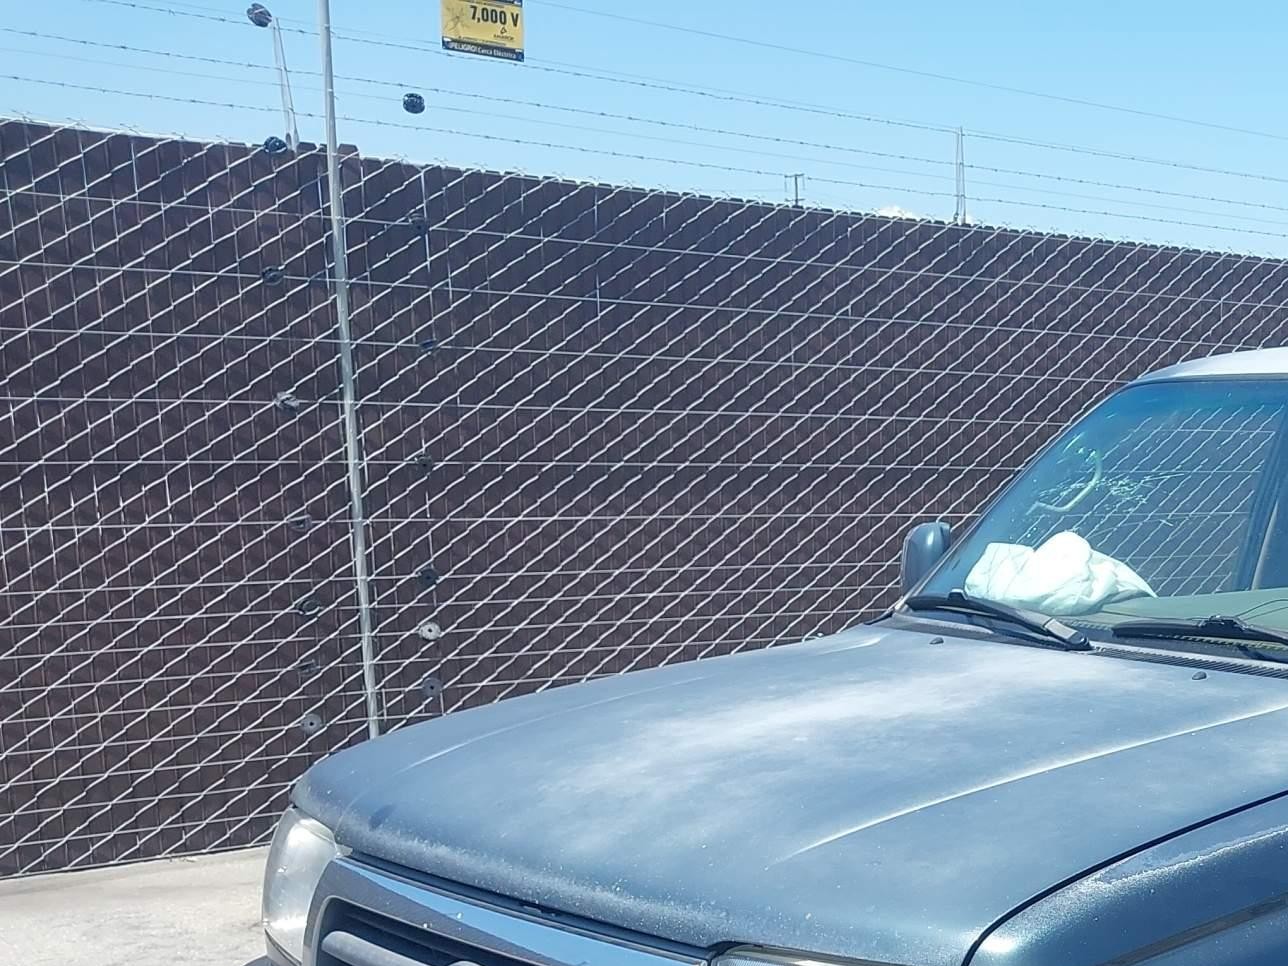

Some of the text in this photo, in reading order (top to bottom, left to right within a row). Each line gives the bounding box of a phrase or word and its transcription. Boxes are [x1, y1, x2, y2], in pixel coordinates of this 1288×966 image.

[470, 5, 519, 27] 7,000 V
[478, 47, 492, 55] Cerca
